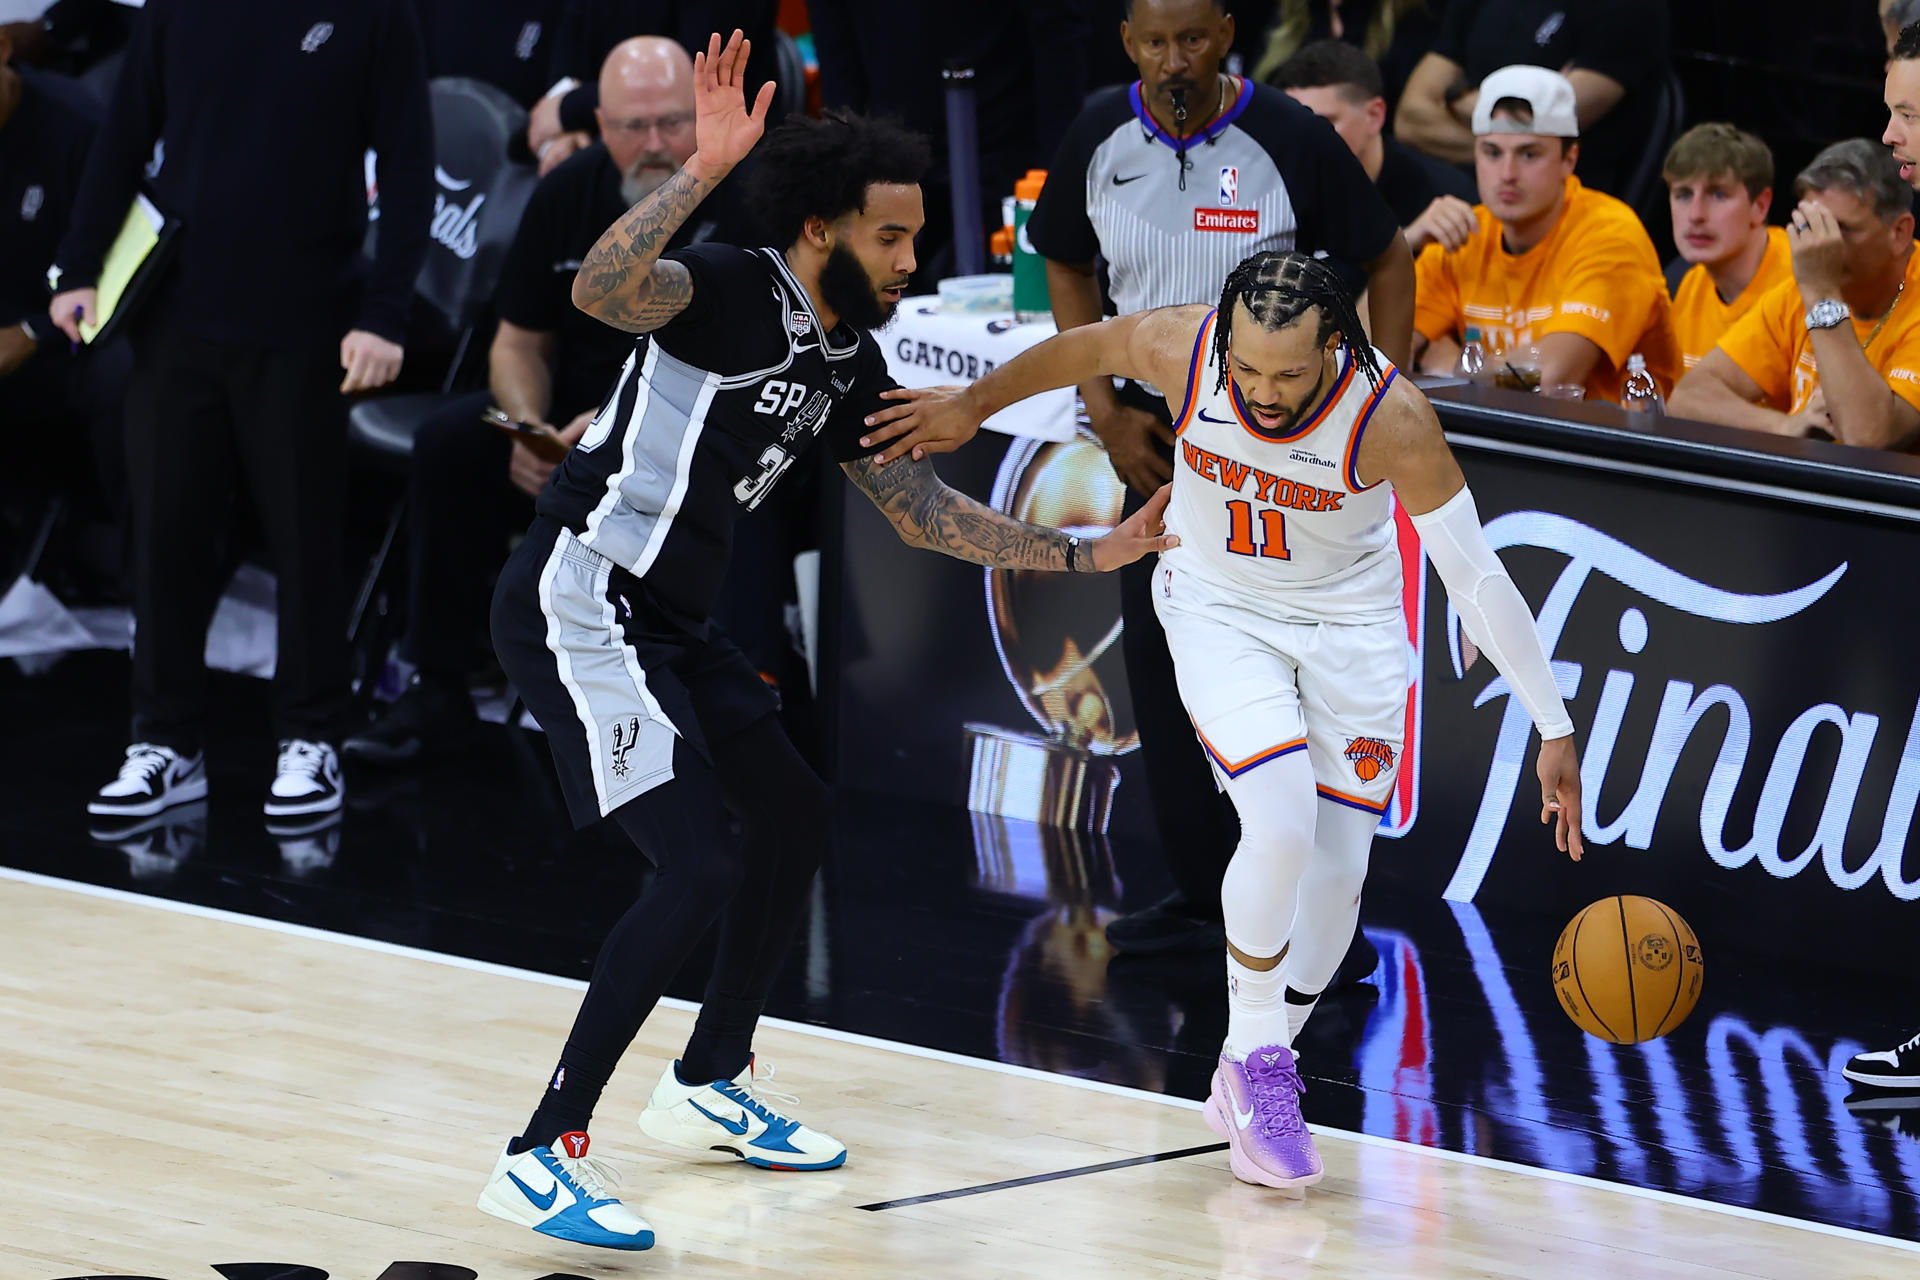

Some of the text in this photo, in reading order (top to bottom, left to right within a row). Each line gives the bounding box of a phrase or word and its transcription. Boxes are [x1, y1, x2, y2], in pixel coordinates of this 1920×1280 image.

[1196, 212, 1257, 229] Emirates
[792, 324, 809, 333] 250
[793, 314, 809, 322] USA
[896, 338, 1000, 380] GATORA
[1289, 453, 1337, 469] abu dhabi
[1182, 438, 1347, 512] NEW YORK
[1226, 500, 1291, 561] 11
[1344, 736, 1393, 768] KNICKS
